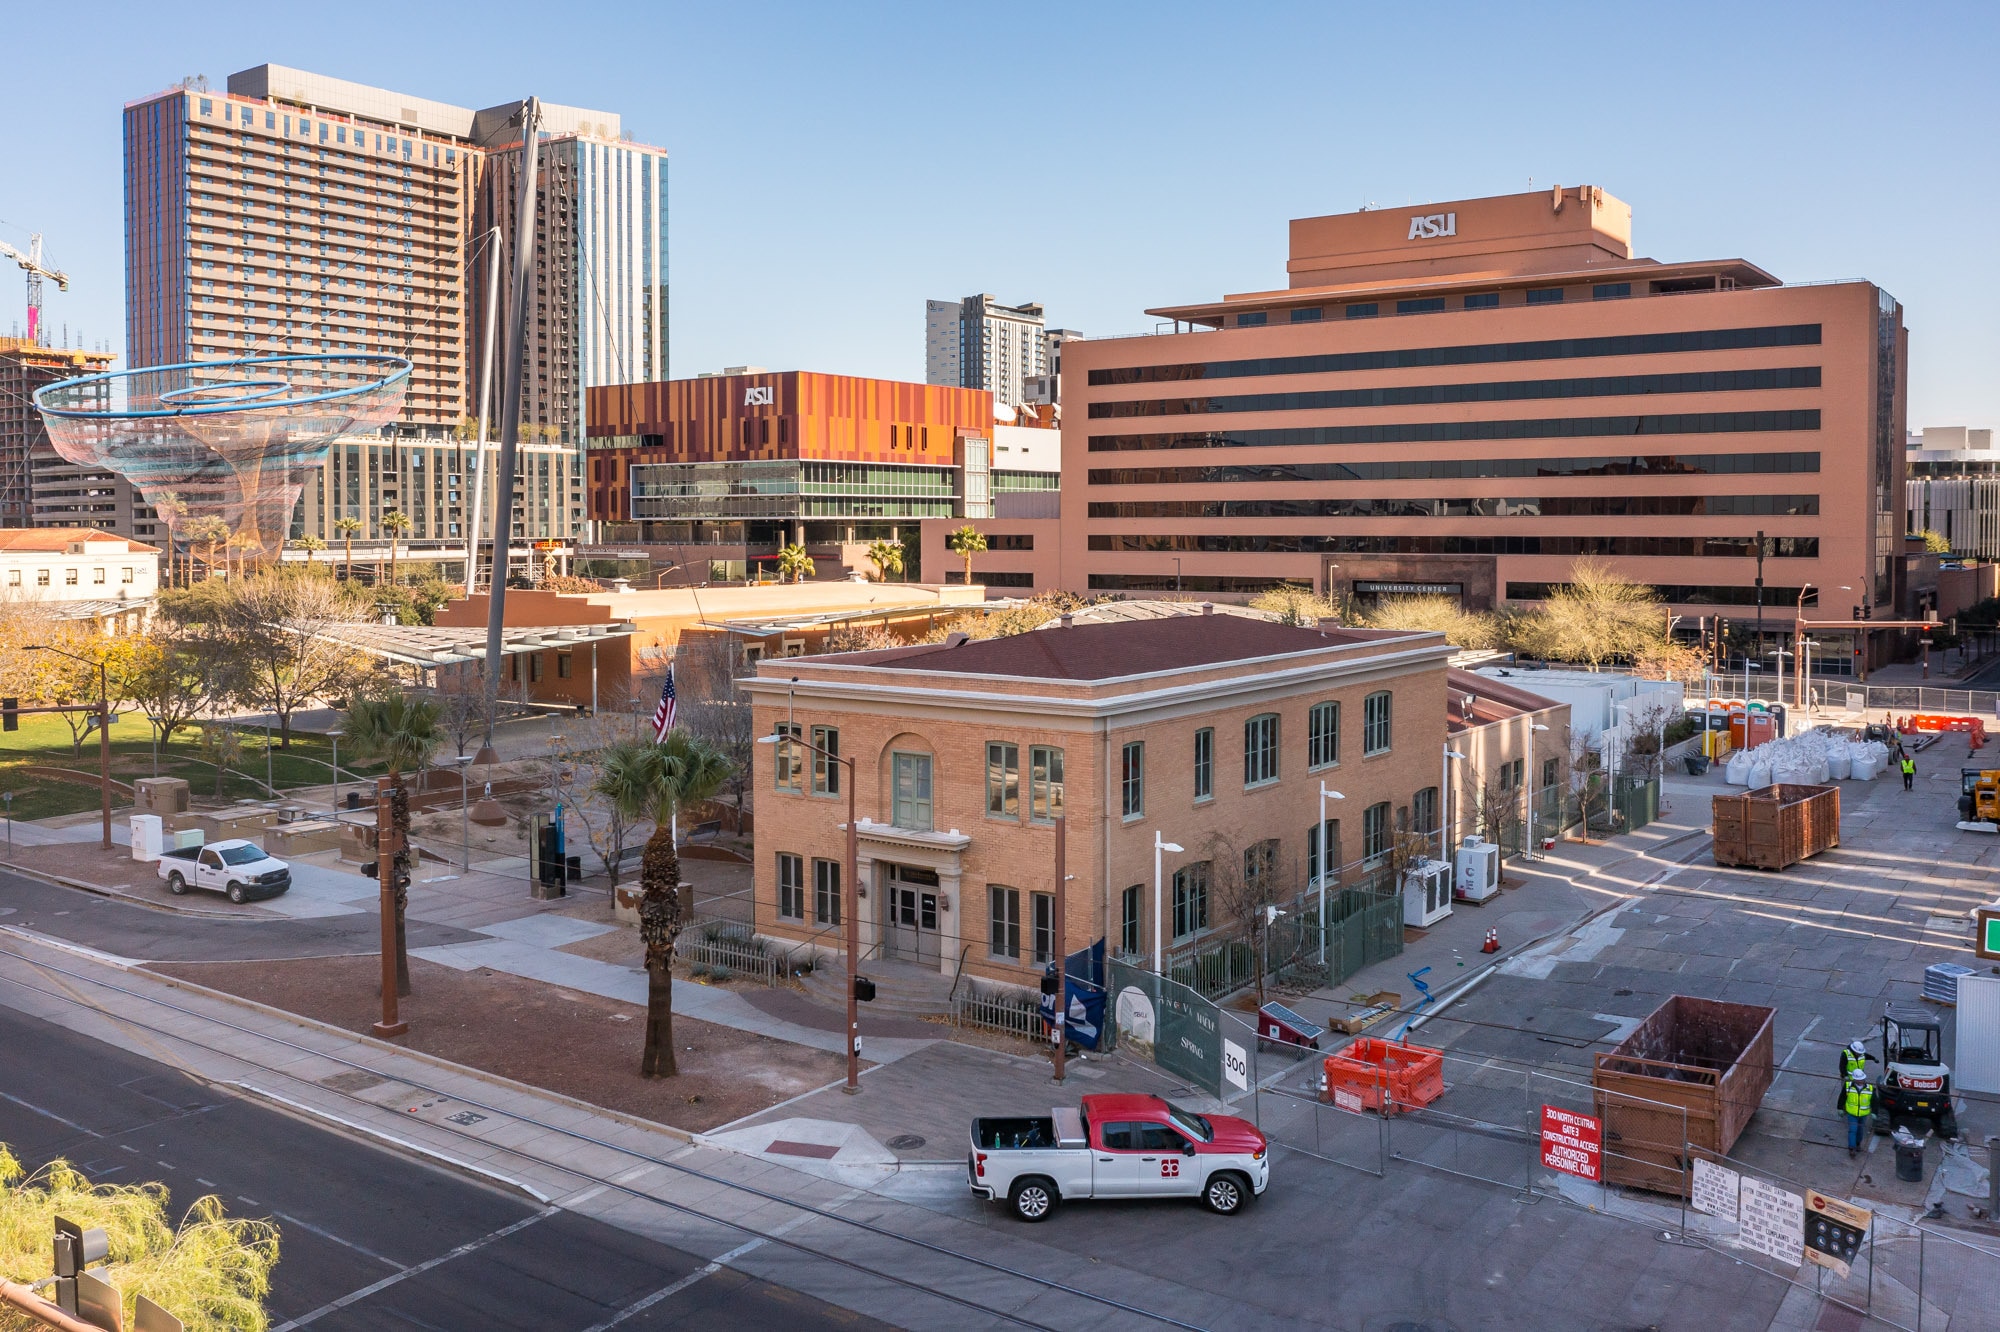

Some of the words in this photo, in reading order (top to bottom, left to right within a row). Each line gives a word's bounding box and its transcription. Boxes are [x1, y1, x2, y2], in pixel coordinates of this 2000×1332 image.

[1408, 212, 1456, 240] ASU
[744, 386, 774, 406] ASU
[1226, 1053, 1245, 1076] 300
[1547, 1108, 1556, 1119] 300
[1557, 1112, 1573, 1124] NORTH
[1574, 1116, 1596, 1130] CENTRAL
[1562, 1124, 1575, 1135] GATE
[1575, 1128, 1579, 1136] 3
[1543, 1130, 1578, 1147] CONSTRUCTION
[1580, 1141, 1598, 1153] ACCESS
[1546, 1154, 1579, 1172] PERSONNEL
[1580, 1164, 1595, 1177] ONLY
[1552, 1145, 1588, 1164] AUTHORIZED
[1766, 1229, 1789, 1242] COMPLAINTS
